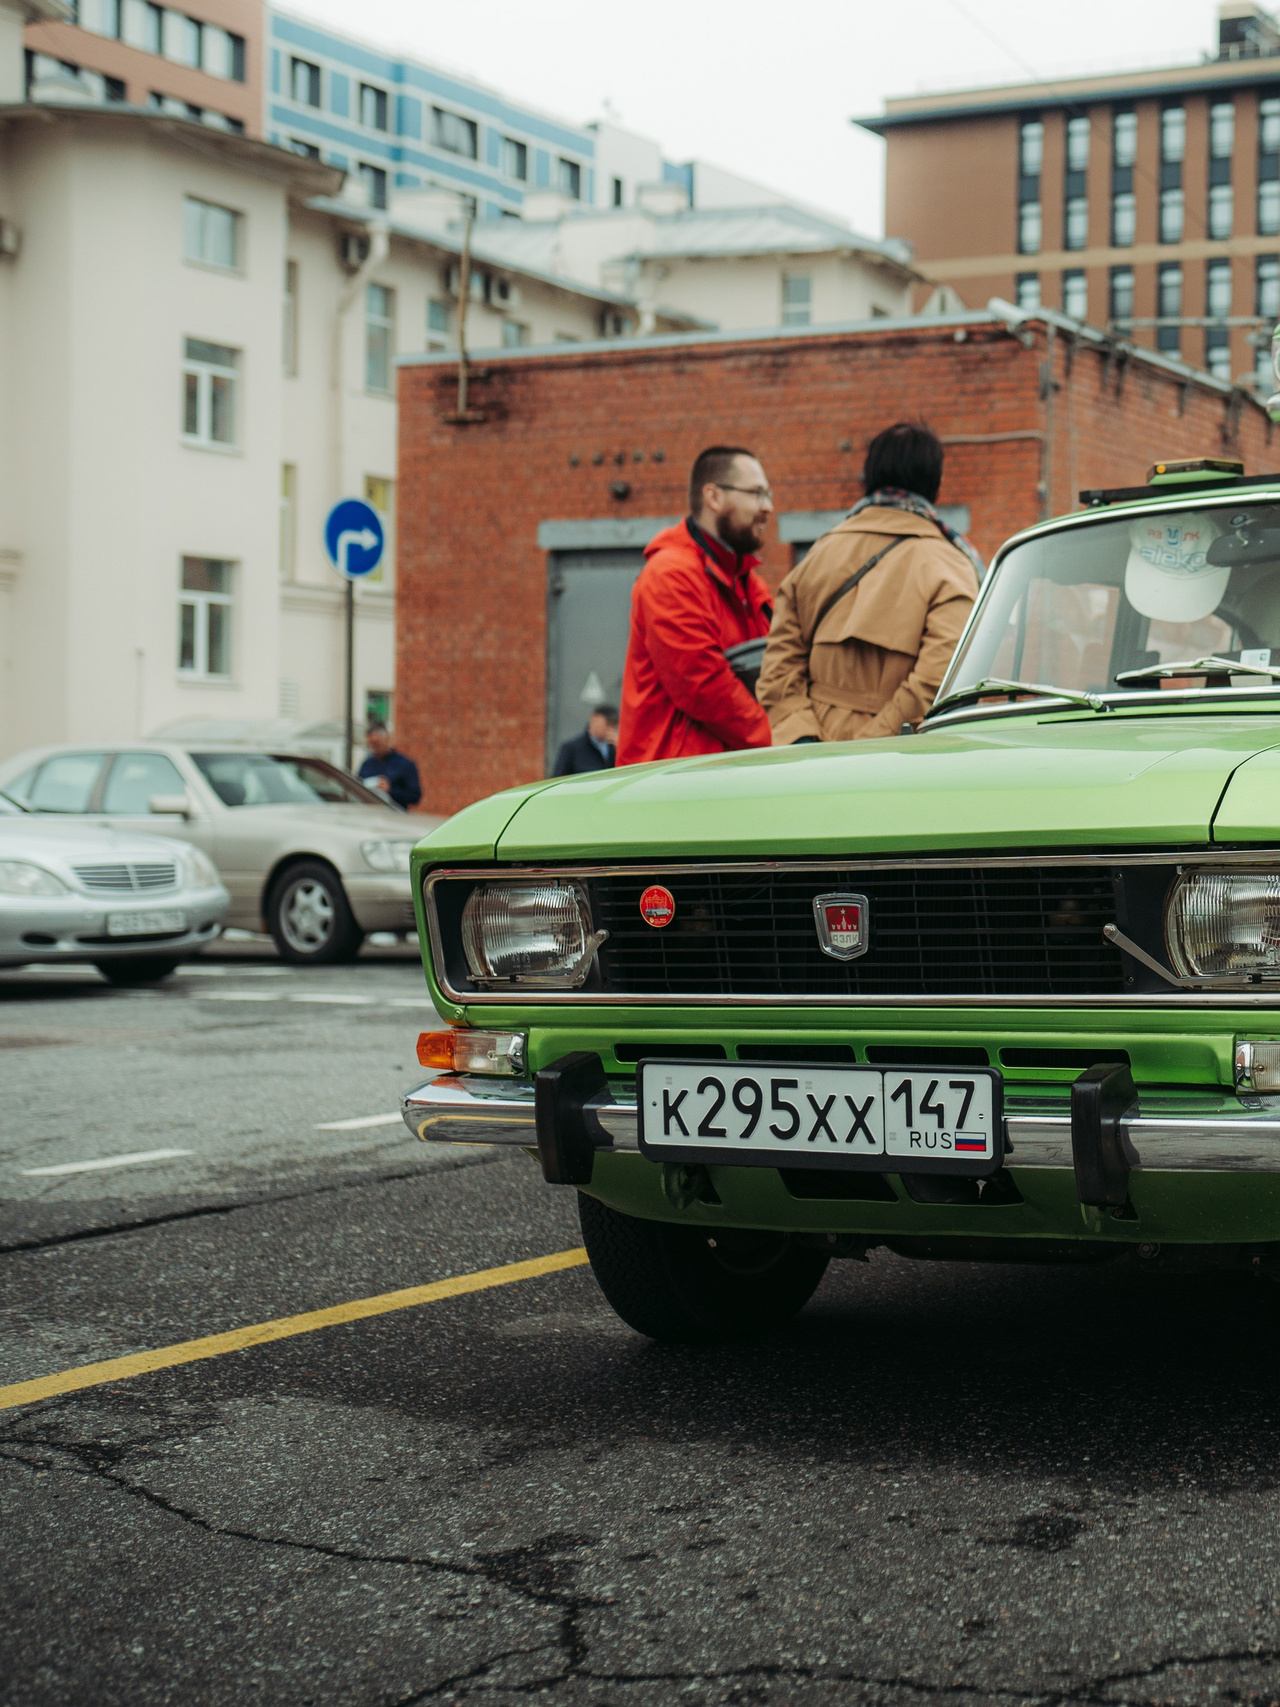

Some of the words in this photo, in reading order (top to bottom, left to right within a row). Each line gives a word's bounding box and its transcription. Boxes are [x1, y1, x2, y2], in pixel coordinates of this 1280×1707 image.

[832, 934, 859, 944] АЗЛК
[890, 1078, 975, 1130] 147
[909, 1131, 953, 1150] RUS
